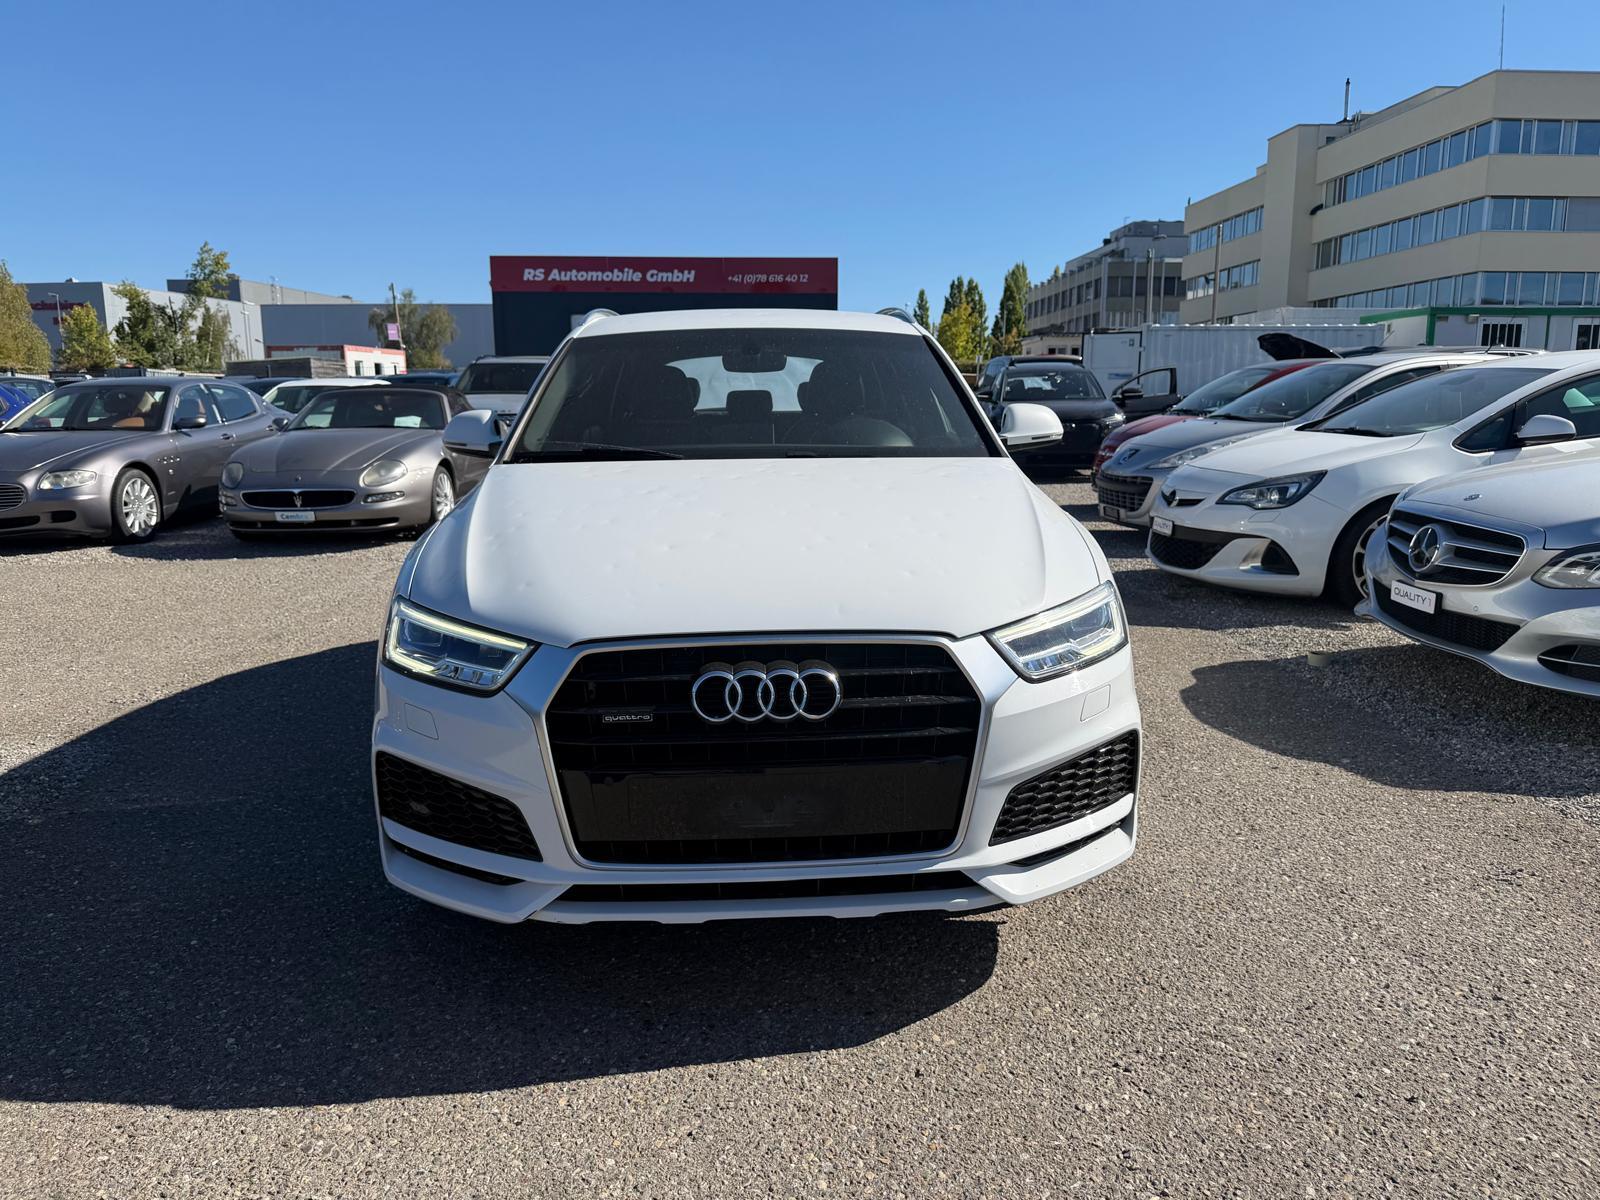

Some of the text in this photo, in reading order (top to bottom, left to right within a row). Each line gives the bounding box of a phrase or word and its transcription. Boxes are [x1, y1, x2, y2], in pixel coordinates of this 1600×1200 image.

[523, 267, 696, 282] RS Automobile GmbH
[728, 273, 809, 284] +41 (0)78 616 40 12
[1393, 586, 1427, 605] QUALITY
[604, 714, 650, 722] quattro
